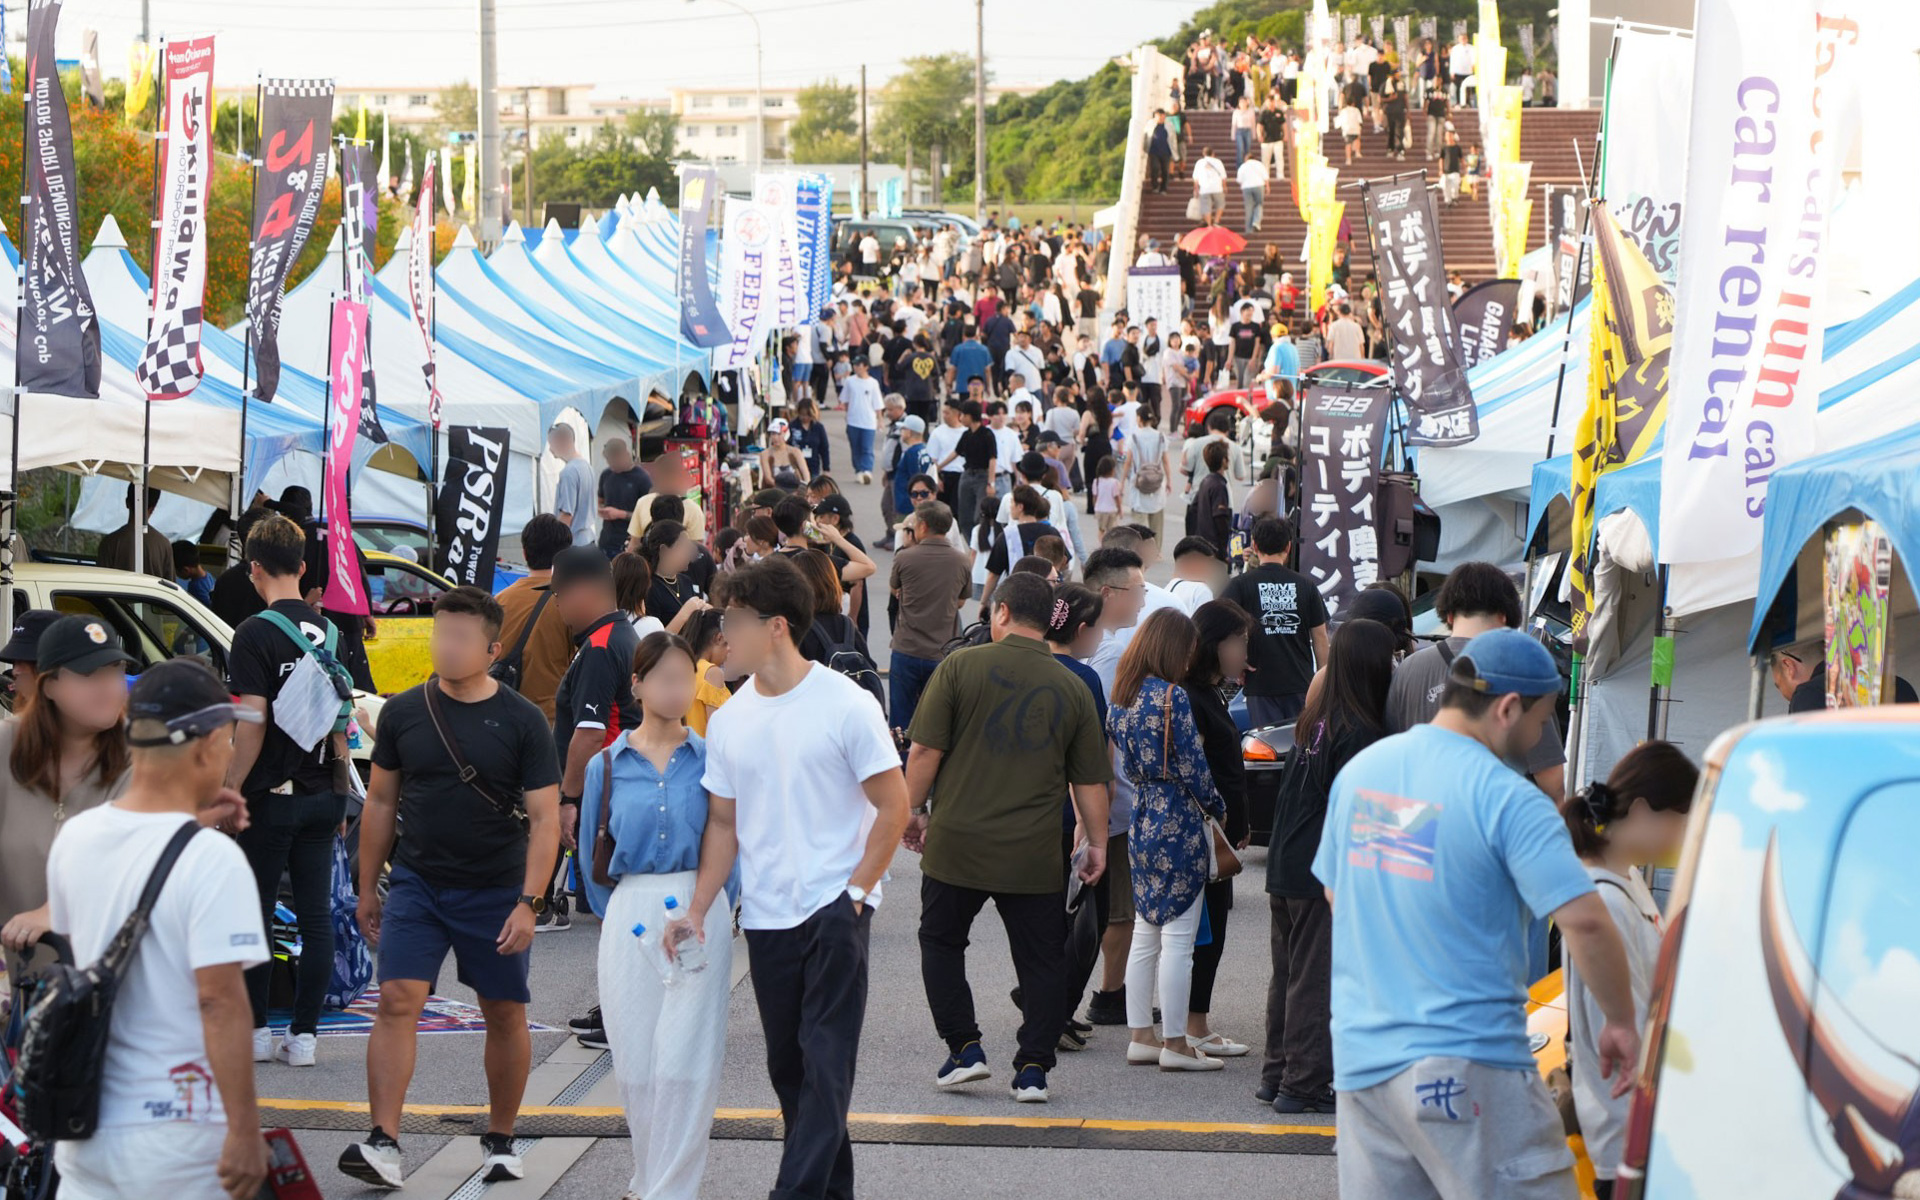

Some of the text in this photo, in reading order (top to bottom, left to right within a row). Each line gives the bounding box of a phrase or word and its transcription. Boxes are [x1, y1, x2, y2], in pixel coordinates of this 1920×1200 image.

[172, 145, 187, 234] MOTORSPORT
[1377, 187, 1412, 209] 358
[1688, 76, 1780, 462] car rental
[730, 250, 763, 366] FEEVIL
[1379, 220, 1422, 400] コーティング
[1314, 394, 1374, 413] 358
[465, 545, 483, 585] Power
[1258, 582, 1296, 591] DRIVE
[1260, 589, 1297, 597] MORE
[1260, 595, 1298, 604] ENJOY
[1261, 602, 1298, 611] MORE
